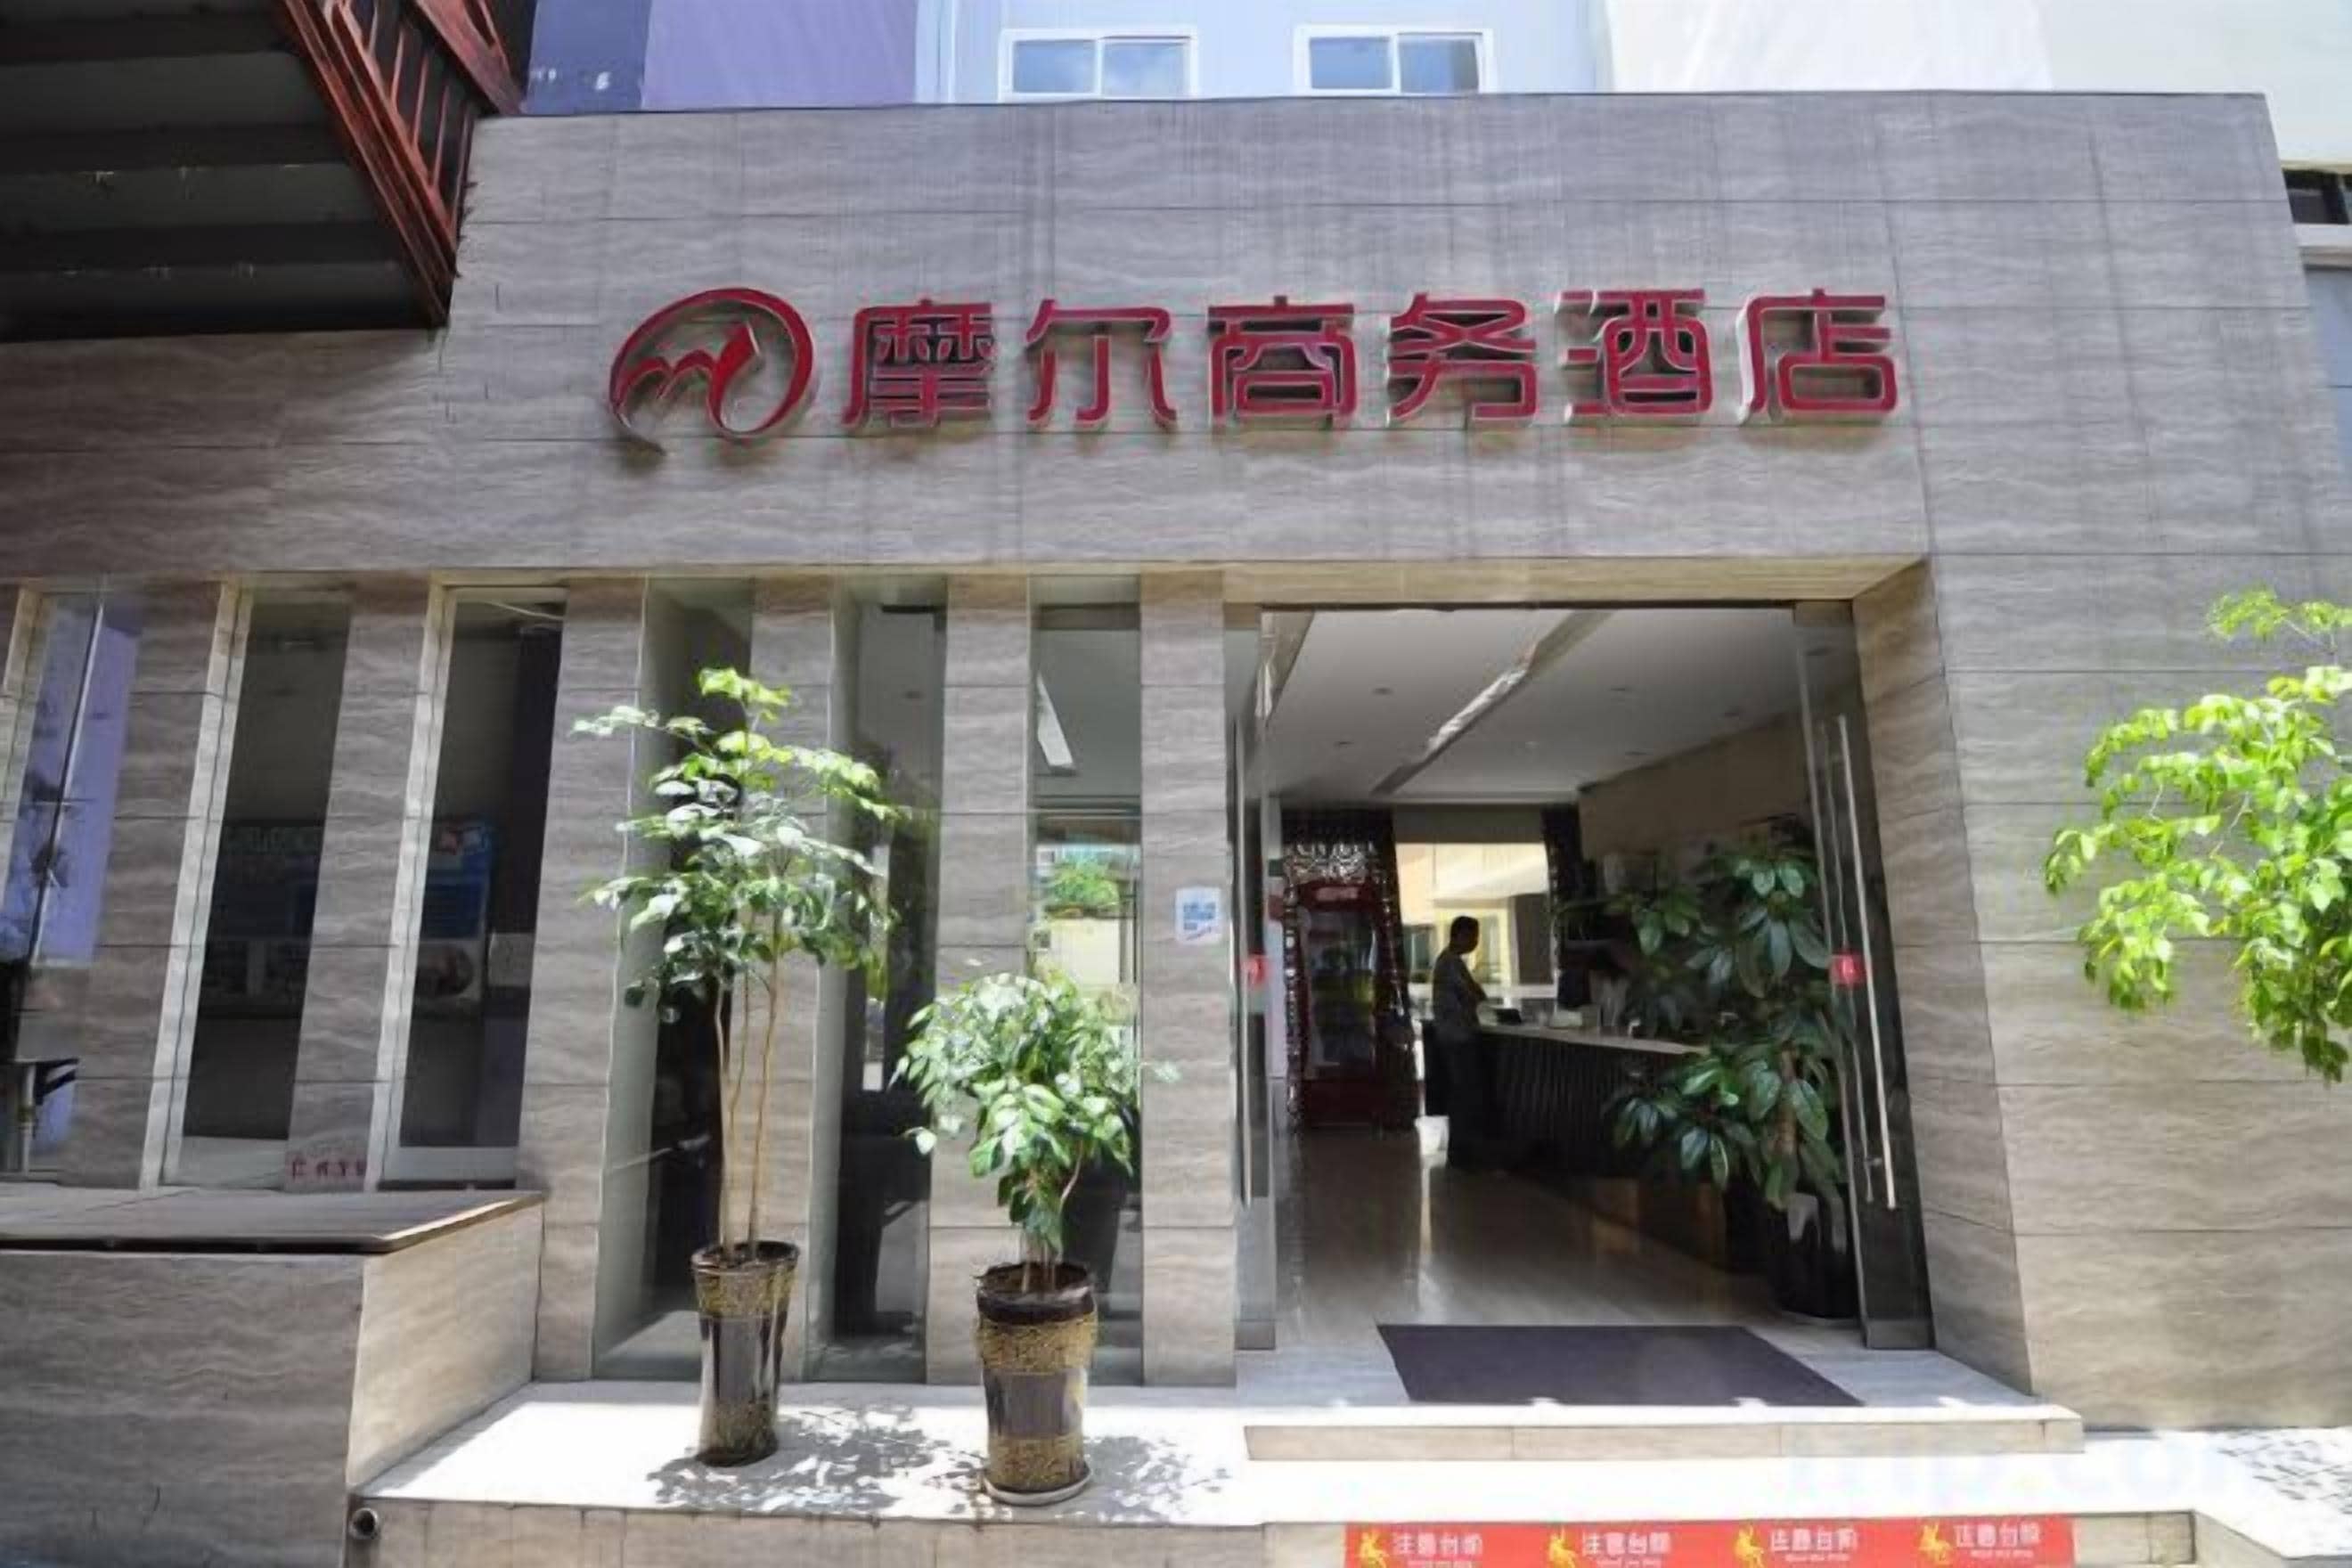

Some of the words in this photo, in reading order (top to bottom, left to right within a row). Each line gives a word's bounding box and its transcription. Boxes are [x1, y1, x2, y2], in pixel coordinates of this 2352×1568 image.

[841, 287, 1899, 431] 摩尔商务酒店
